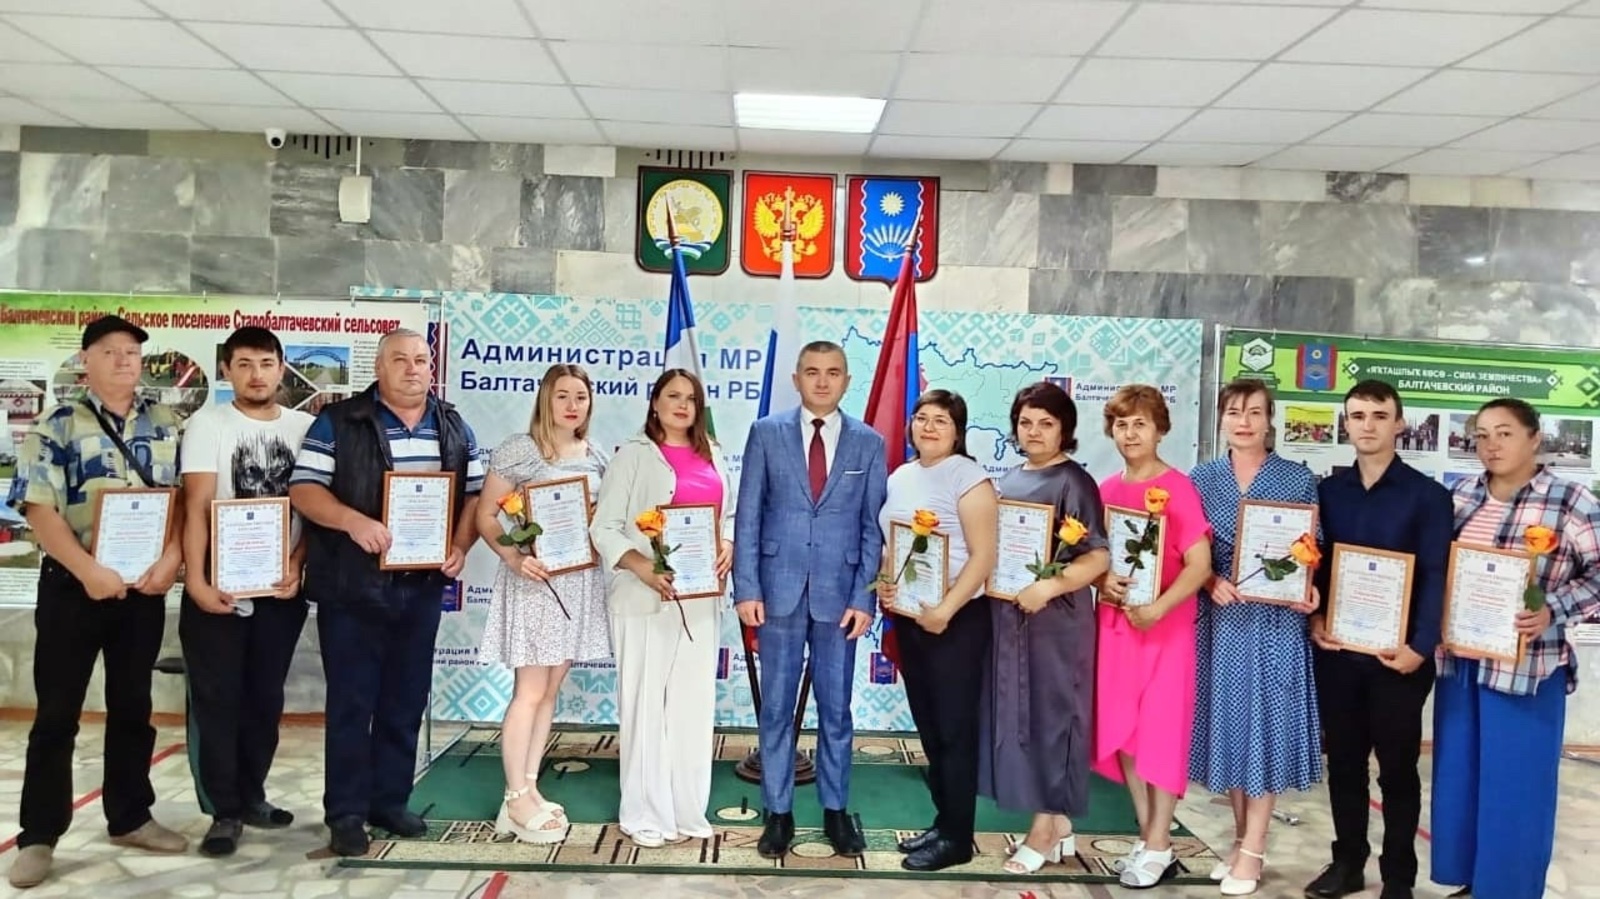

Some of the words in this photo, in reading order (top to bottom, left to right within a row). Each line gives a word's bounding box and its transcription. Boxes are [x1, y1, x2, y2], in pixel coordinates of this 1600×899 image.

[171, 311, 230, 330] поселение
[233, 309, 341, 333] Старобалтачевский
[344, 317, 401, 334] сельсовет
[720, 348, 762, 370] МР
[728, 381, 761, 400] РБ
[1398, 379, 1475, 393] БАЛТАЧЕВСКИЙ
[1476, 383, 1511, 394] РАЙОН
